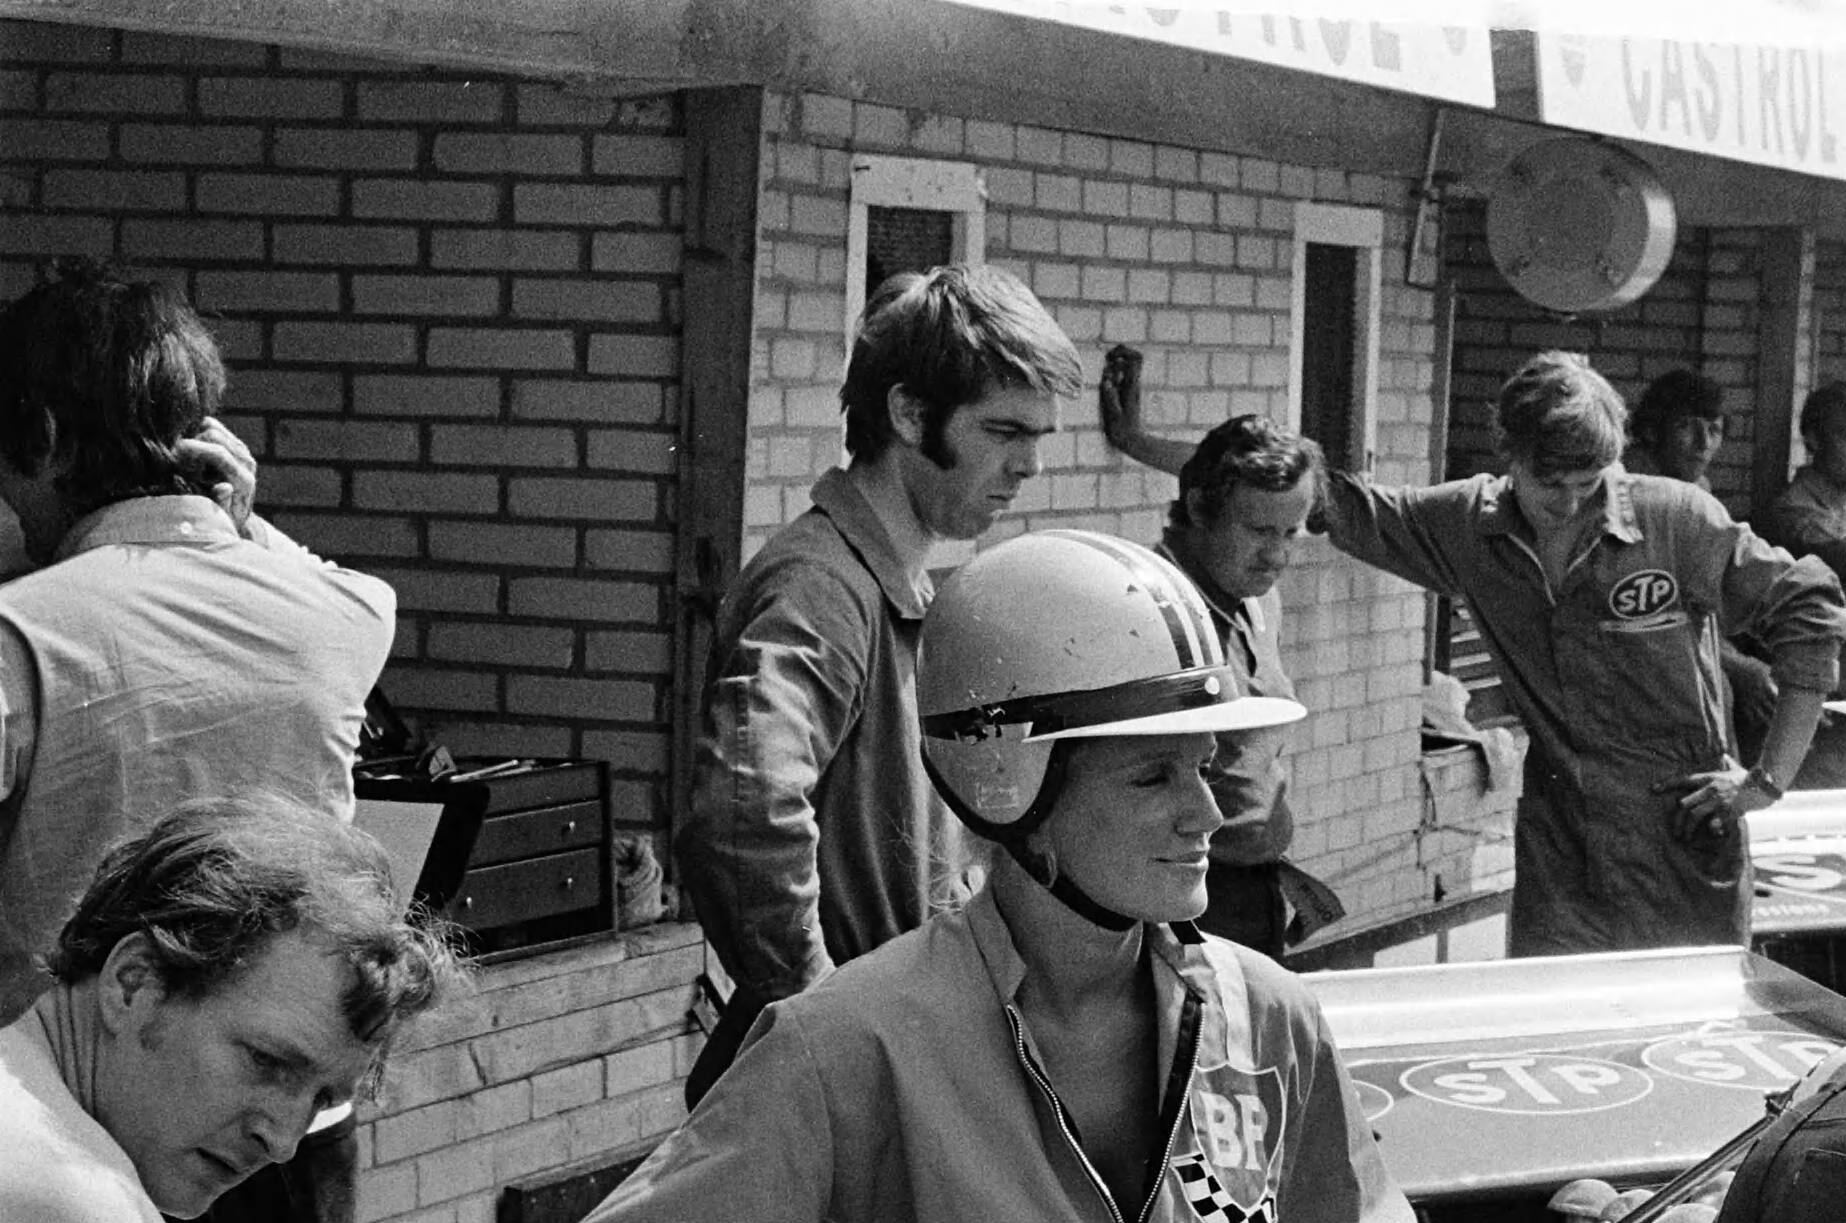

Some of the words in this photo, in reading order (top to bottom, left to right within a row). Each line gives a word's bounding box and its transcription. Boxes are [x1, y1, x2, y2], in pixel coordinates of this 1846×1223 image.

[1621, 38, 1838, 164] CASTROL
[1618, 575, 1670, 612] STP
[1433, 1057, 1622, 1106] STP
